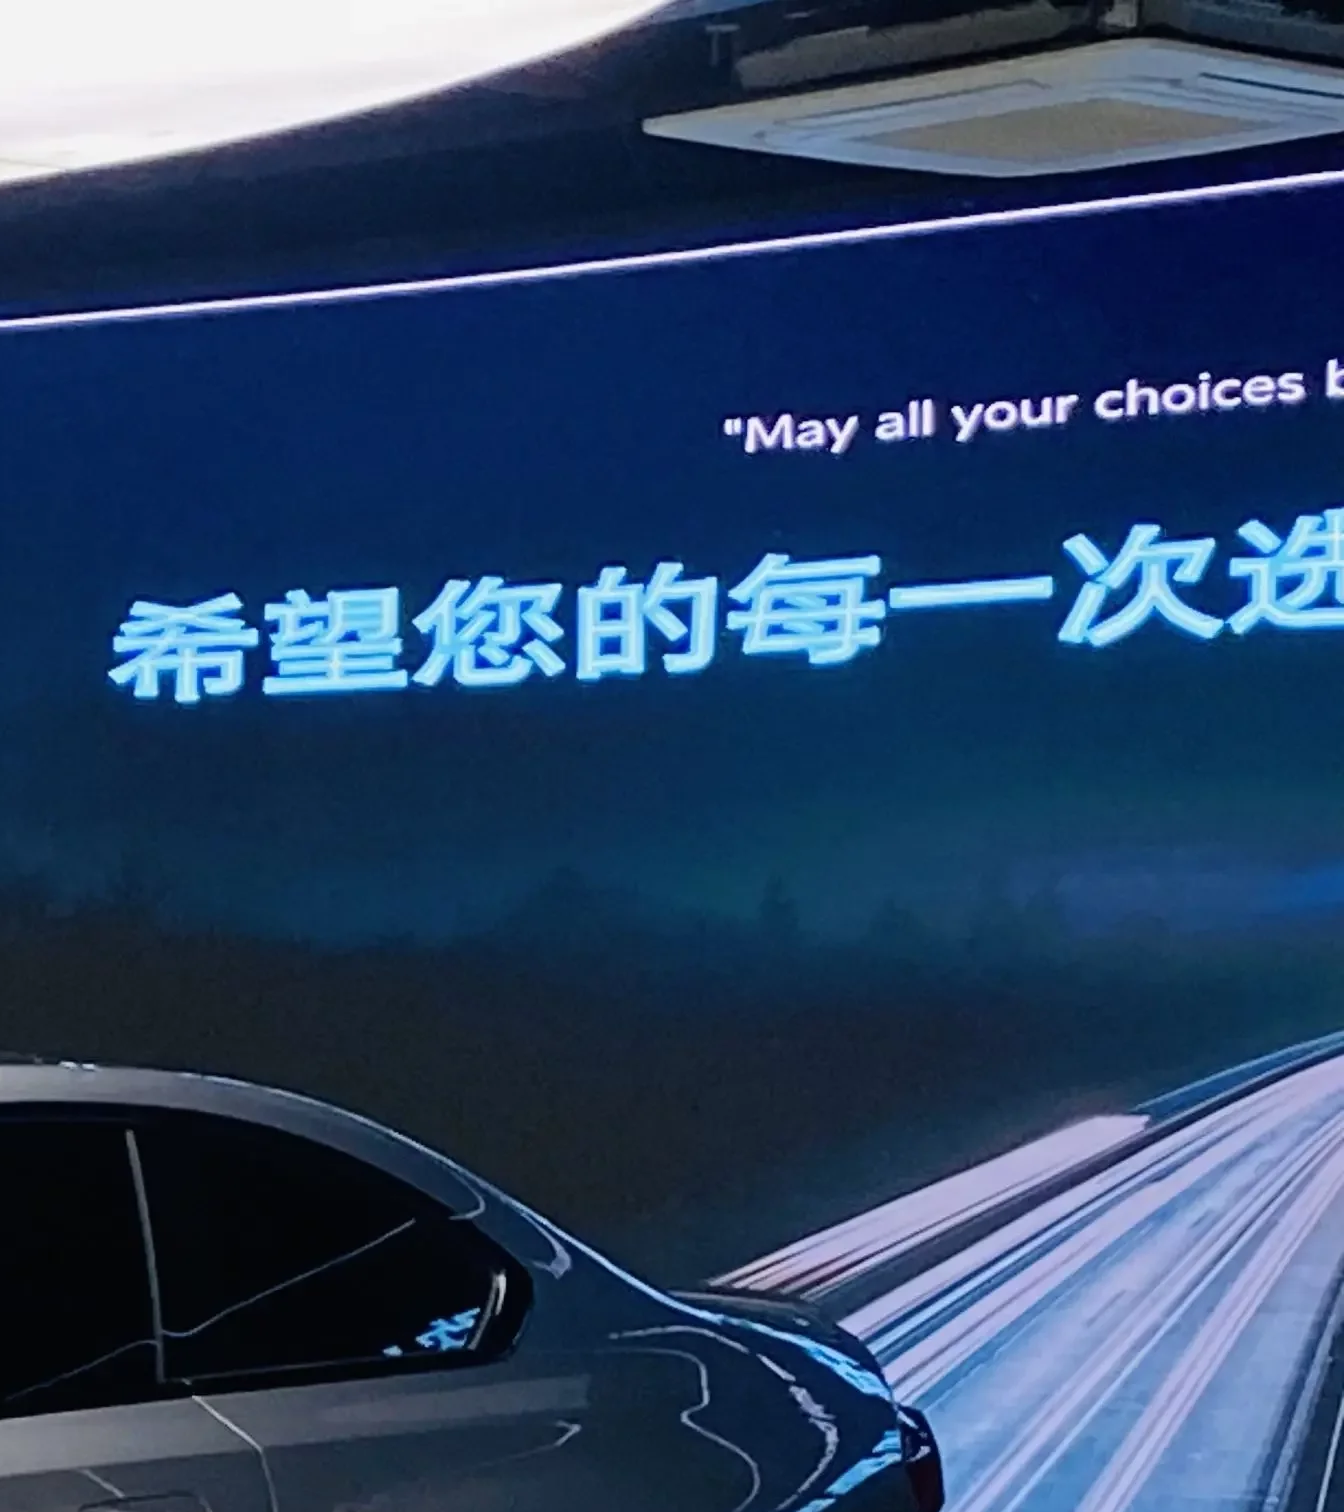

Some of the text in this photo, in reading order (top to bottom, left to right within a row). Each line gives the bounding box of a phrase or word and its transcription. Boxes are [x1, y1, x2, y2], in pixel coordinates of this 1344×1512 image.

[723, 413, 860, 454] "May
[875, 398, 936, 441] all
[951, 393, 1080, 443] your
[1093, 371, 1306, 419] choices
[107, 507, 1344, 704] 希望您的每一次选
